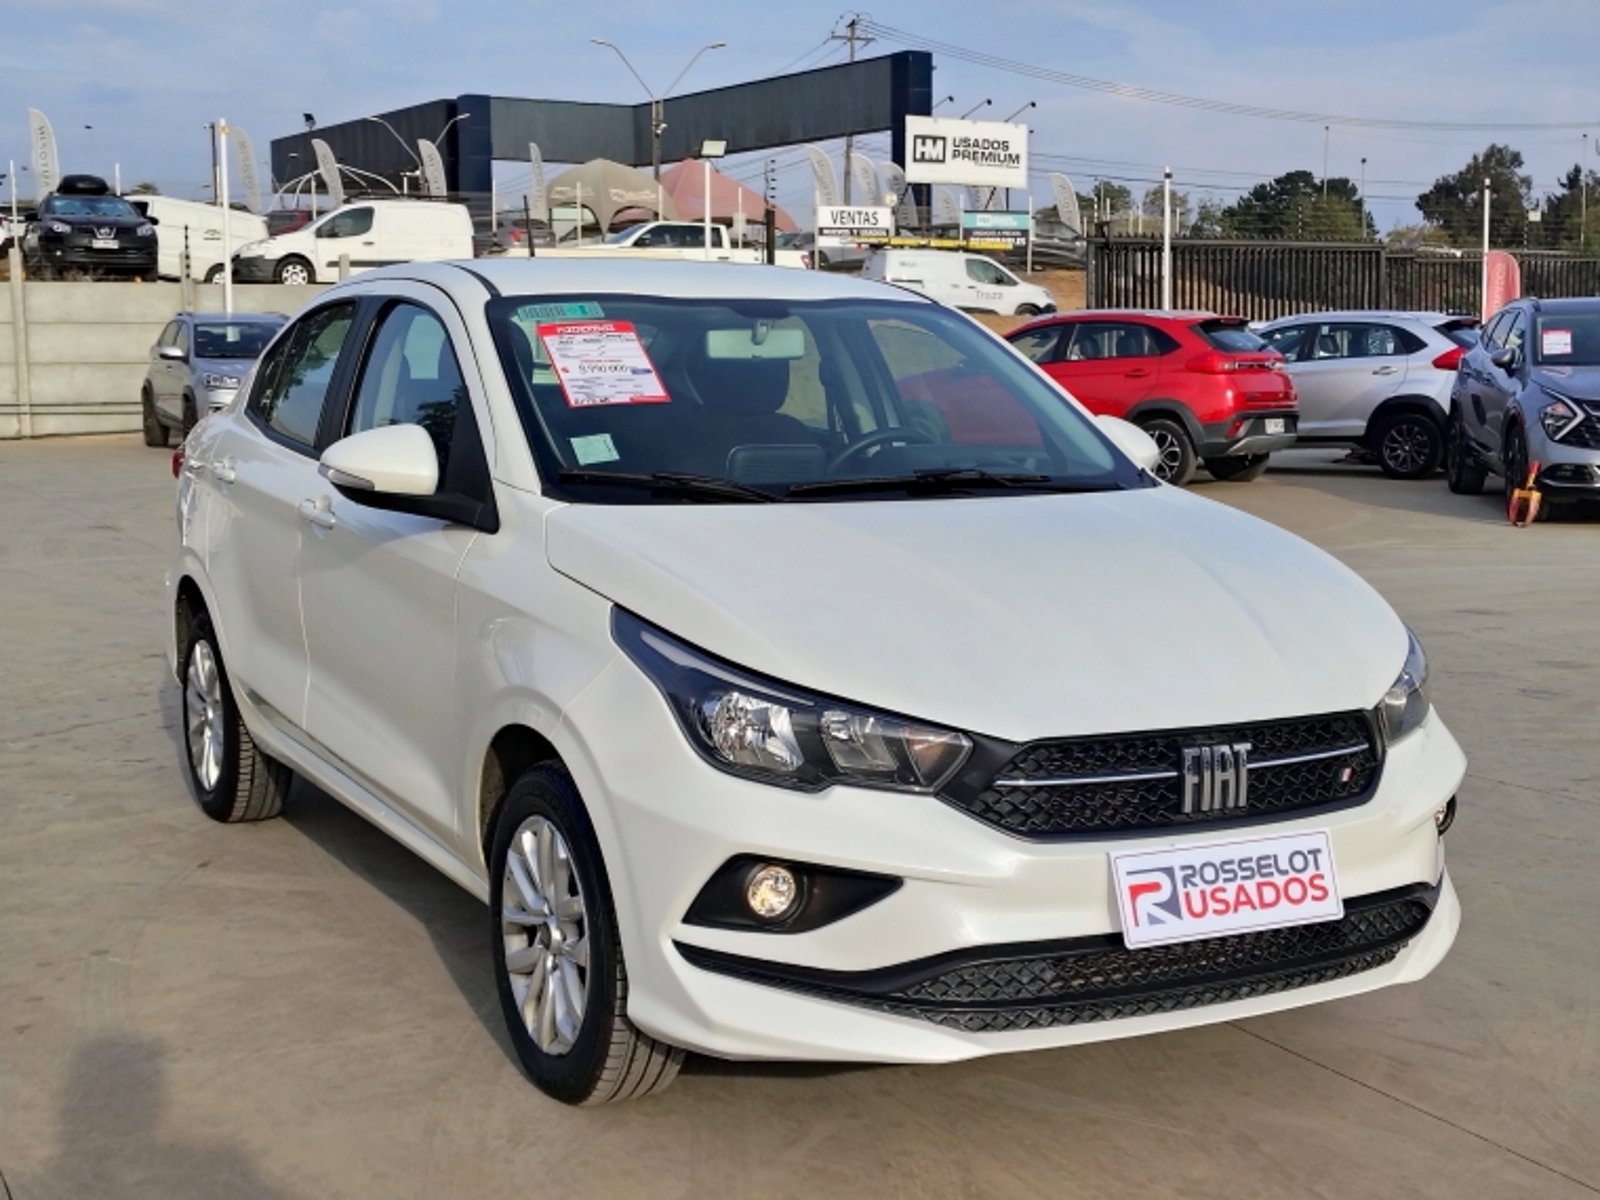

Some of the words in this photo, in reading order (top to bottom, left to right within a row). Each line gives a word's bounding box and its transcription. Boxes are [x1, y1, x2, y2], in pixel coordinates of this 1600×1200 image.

[913, 135, 946, 162] HM
[952, 137, 1009, 151] USADOS
[952, 148, 1020, 165] PREMIUM
[831, 209, 878, 226] VENTAS
[1181, 742, 1253, 814] FIAT
[1179, 848, 1322, 888] ROSSELOT
[1184, 873, 1329, 919] USADOS
